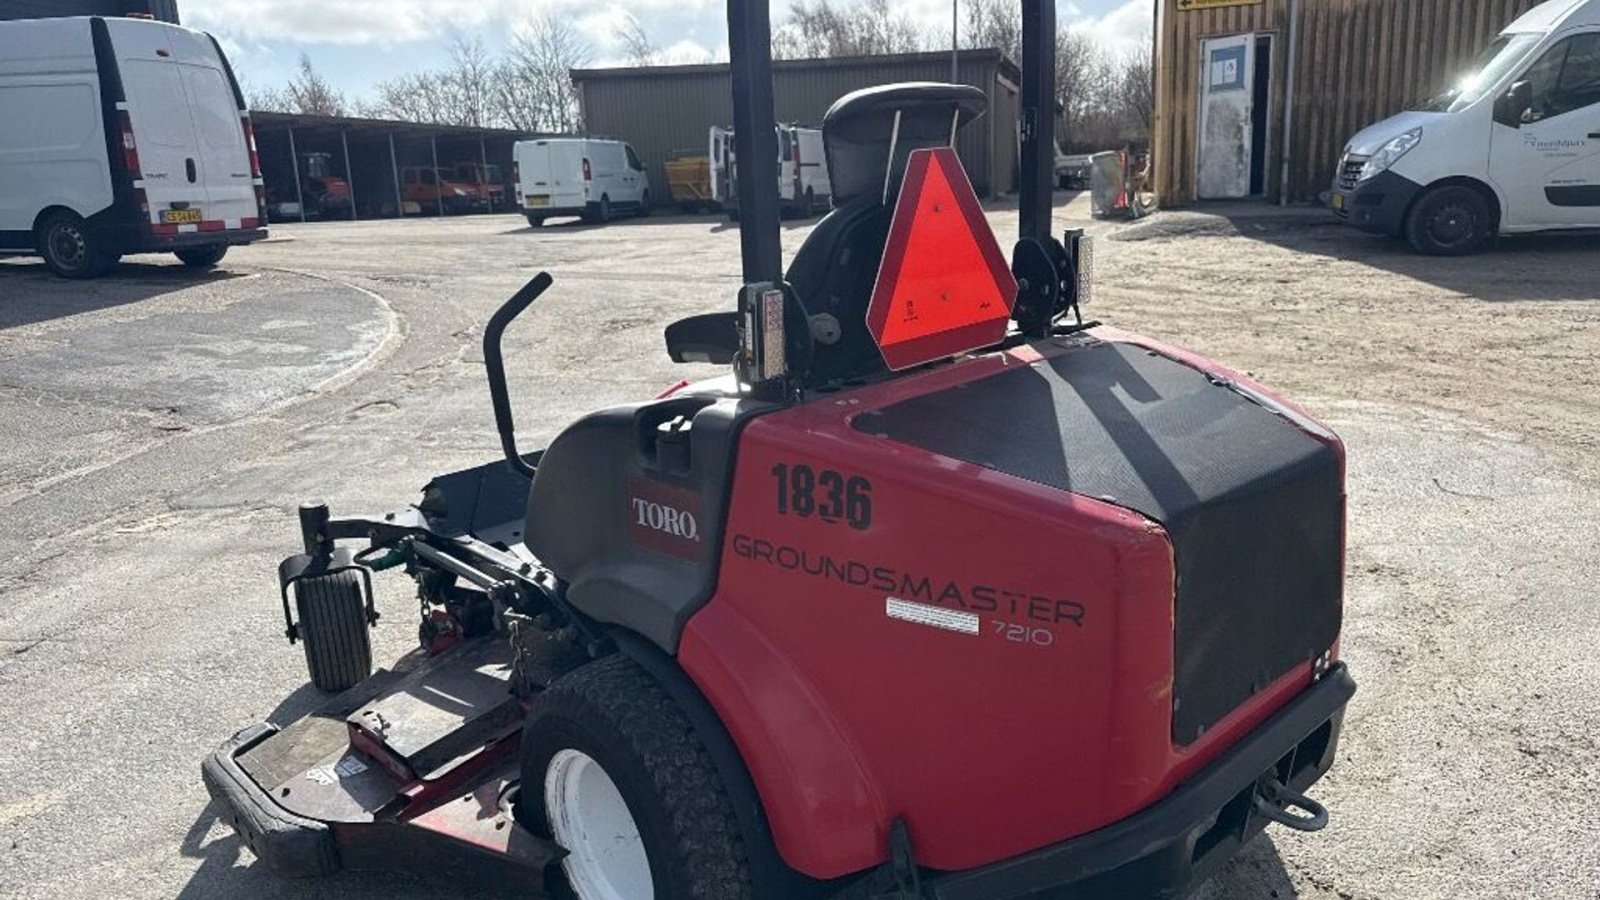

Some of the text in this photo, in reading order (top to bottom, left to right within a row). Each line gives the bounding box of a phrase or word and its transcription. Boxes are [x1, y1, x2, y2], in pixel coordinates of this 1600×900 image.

[771, 463, 872, 530] 1836
[733, 534, 1086, 628] GROUNDSMASTER
[992, 610, 1053, 646] 7210
